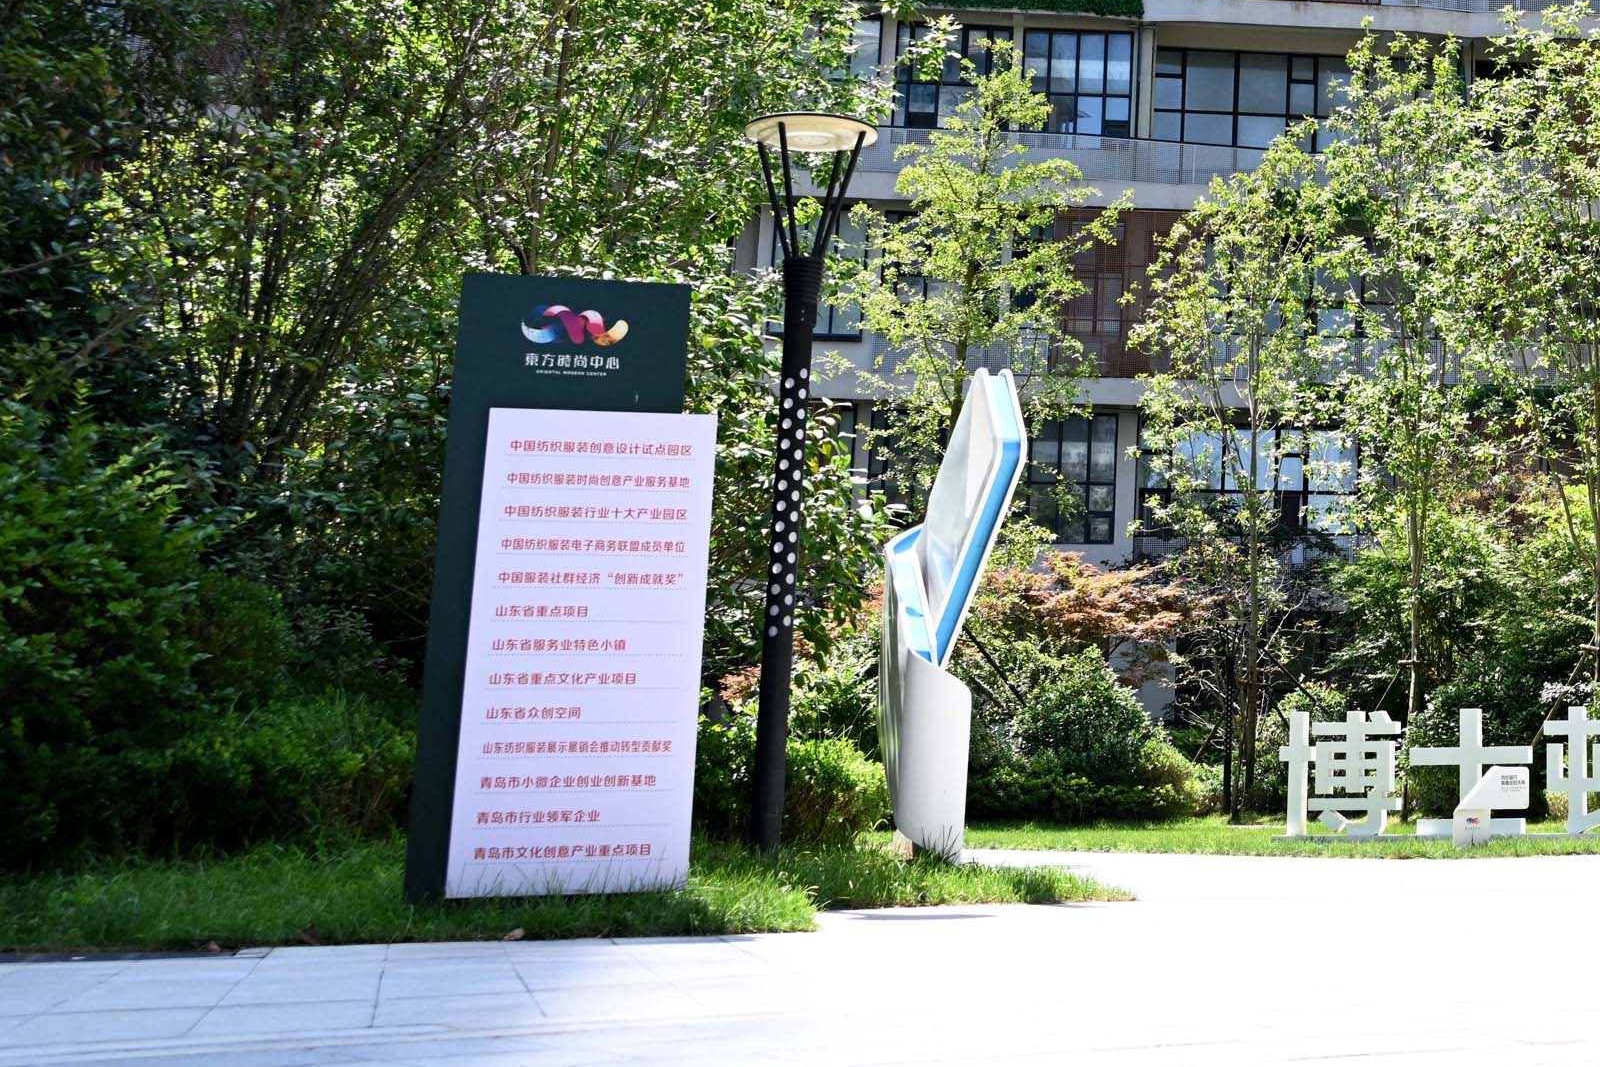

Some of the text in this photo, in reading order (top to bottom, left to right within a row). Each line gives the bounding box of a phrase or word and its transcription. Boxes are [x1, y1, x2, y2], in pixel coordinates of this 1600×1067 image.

[523, 352, 620, 370] 東方時尚中心
[510, 439, 692, 457] 中国纺织服装创意设计试点园区
[507, 472, 690, 488] 中国纺织服装时尚创意产业服务基地
[504, 505, 688, 520] 中国纺织服装行业十大产业园区
[501, 538, 685, 553] 中国纺织服装电子商务联盟成员单位
[495, 605, 589, 617] 山东省重点项目
[492, 638, 627, 651] 山东省服务业特色小镇
[489, 672, 637, 685] 山东省重点文化产业项目
[486, 707, 582, 719] 山东省众创空间
[480, 774, 657, 789] 青岛市小微企业创业创新基地
[477, 810, 600, 824] 青岛市行业领军企业
[474, 844, 651, 860] 青岛市文化创意产业重点项目
